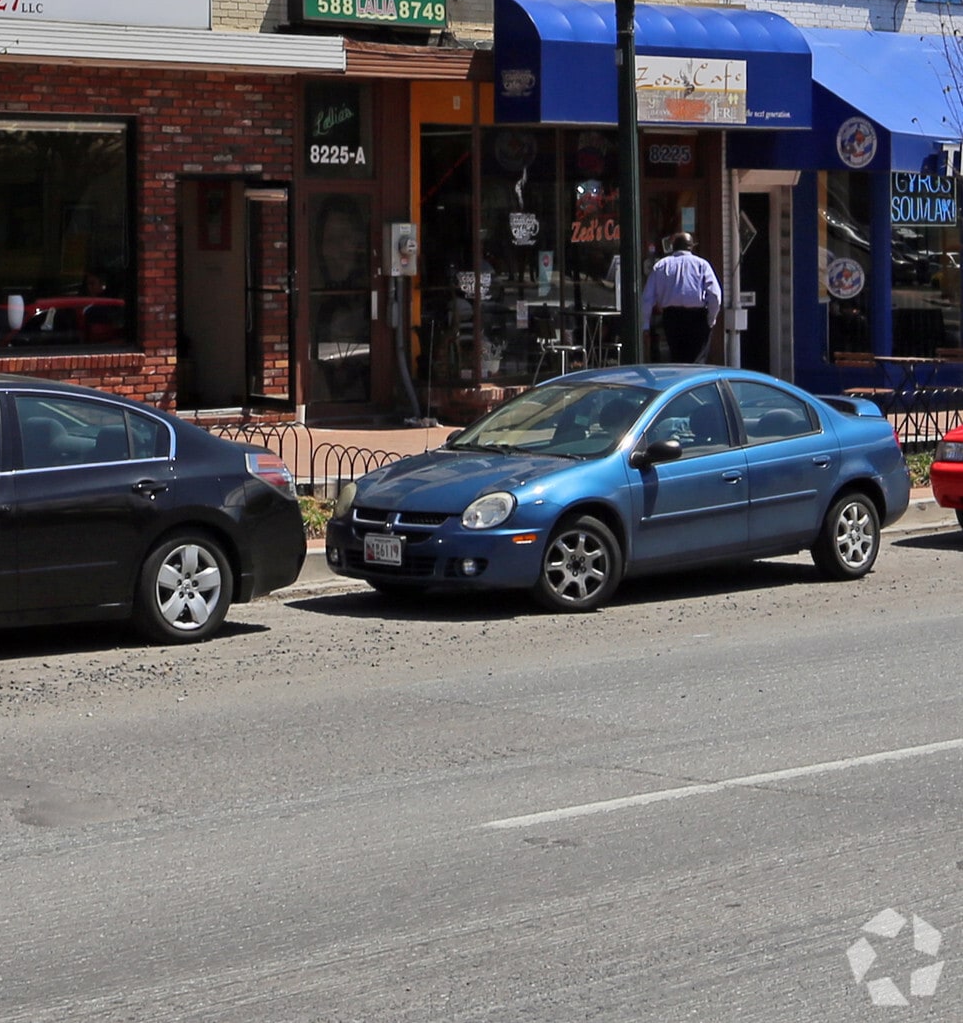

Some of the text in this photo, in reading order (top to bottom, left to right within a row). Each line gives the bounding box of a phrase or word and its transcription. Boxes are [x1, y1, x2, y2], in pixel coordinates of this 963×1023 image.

[21, 3, 44, 14] LLC
[399, 1, 445, 21] 8749
[310, 144, 366, 165] 8225-A
[649, 145, 691, 164] 8225
